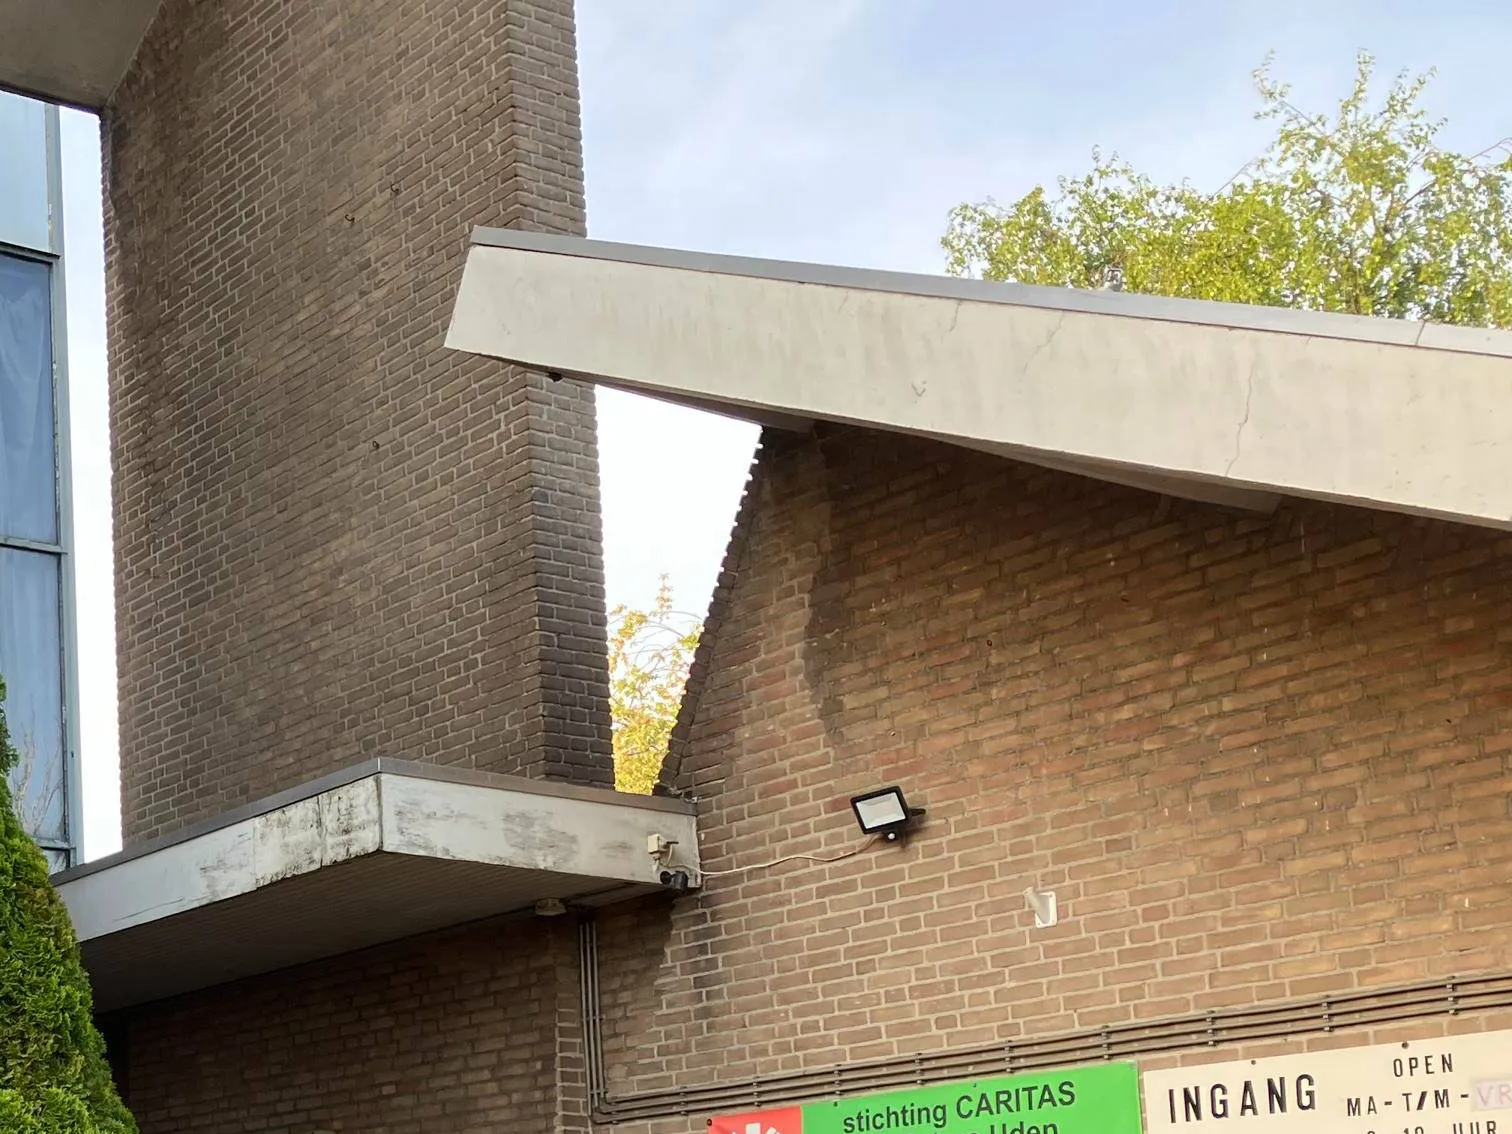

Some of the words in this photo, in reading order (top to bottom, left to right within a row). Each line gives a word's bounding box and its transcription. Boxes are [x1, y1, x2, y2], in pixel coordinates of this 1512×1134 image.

[1393, 1053, 1454, 1078] OPEN
[843, 1102, 947, 1134] stichting
[956, 1081, 1076, 1120] CARITAS
[1168, 1073, 1317, 1124] INGANG
